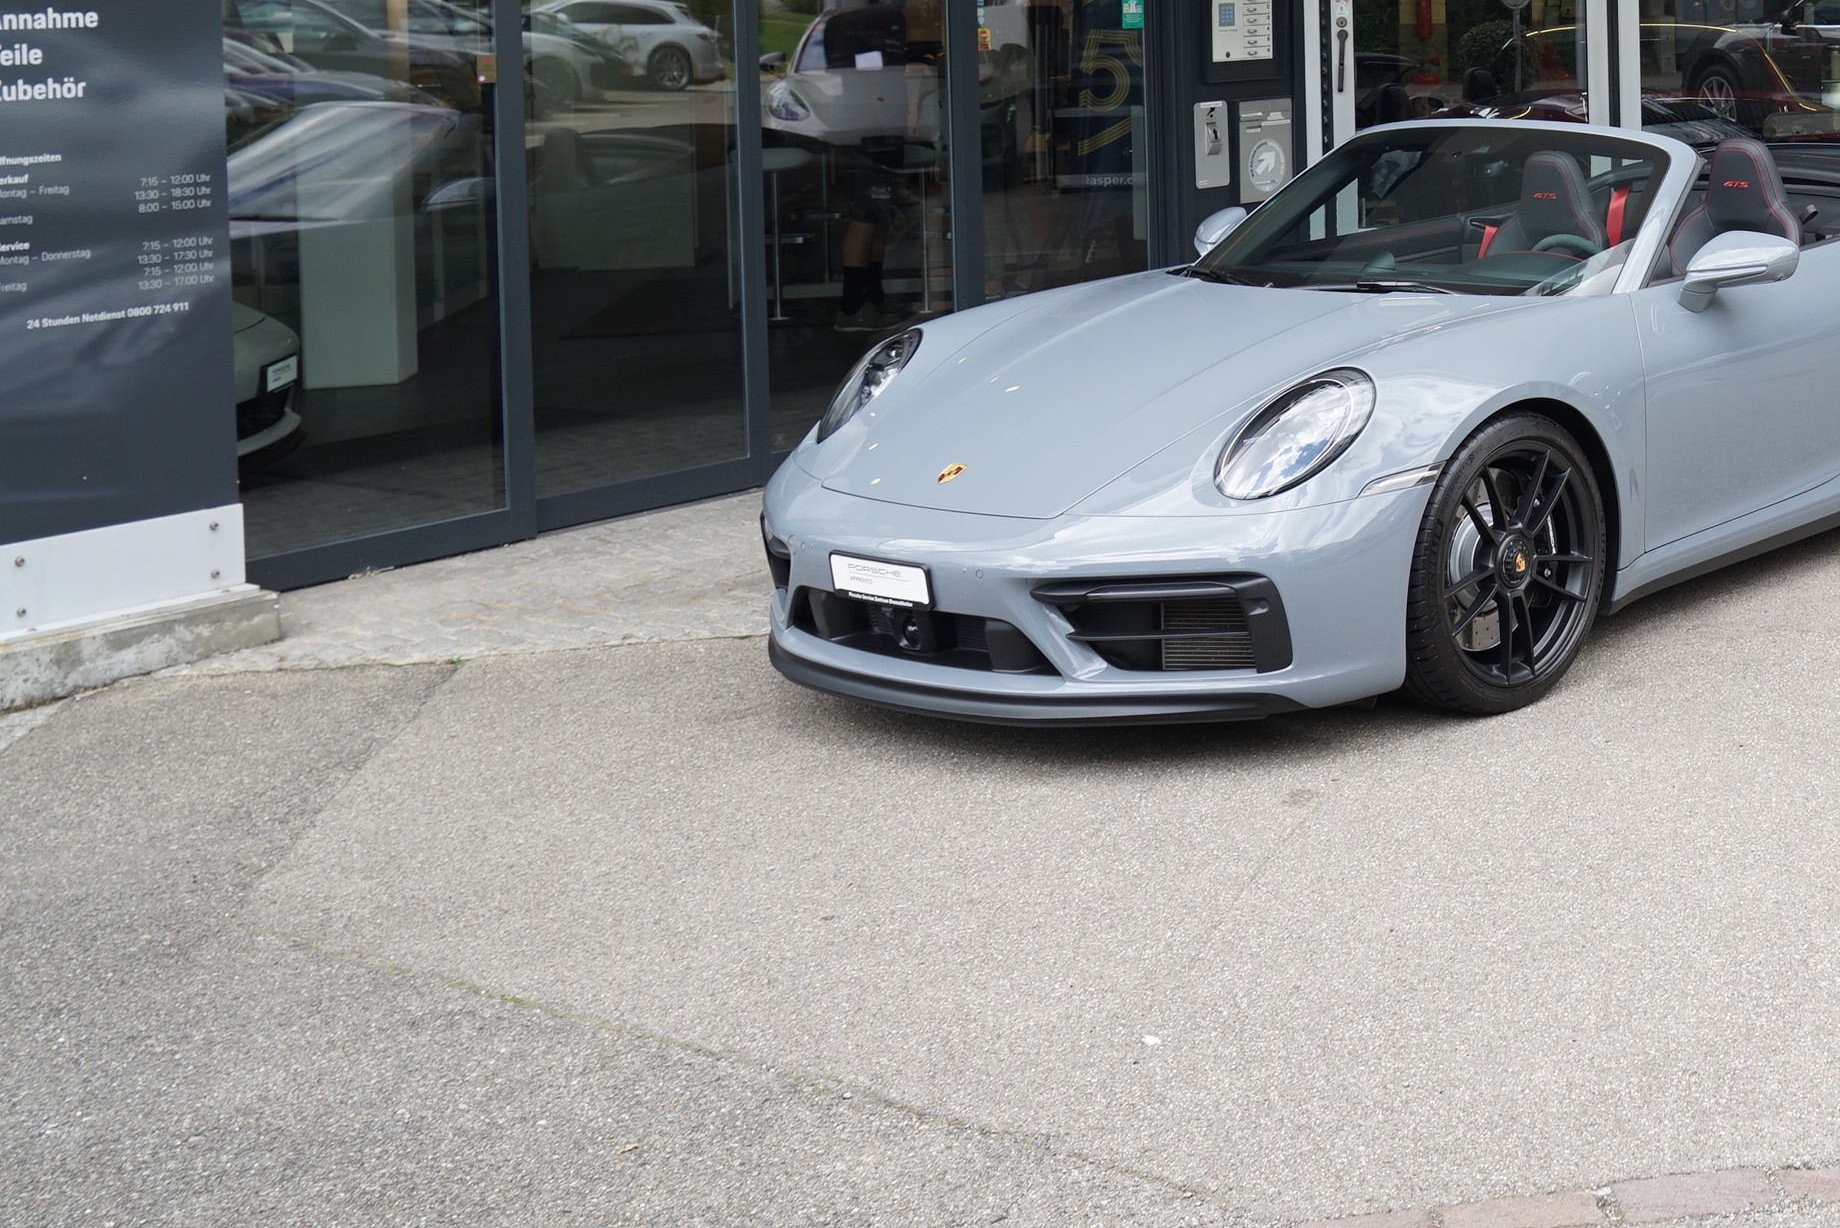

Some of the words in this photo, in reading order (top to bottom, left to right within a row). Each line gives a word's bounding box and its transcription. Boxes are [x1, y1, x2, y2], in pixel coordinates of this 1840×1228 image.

[196, 174, 211, 183] Uhr
[1723, 180, 1749, 189] GTS
[0, 188, 27, 200] ontag
[38, 184, 70, 196] Freitag
[196, 186, 211, 196] Uhr
[1533, 192, 1557, 200] GTS
[197, 198, 212, 209] Uhr
[198, 237, 214, 247] Uhr
[41, 249, 91, 262] Donnerstag
[199, 249, 214, 259] Uhr
[199, 262, 214, 272] Uhr
[199, 275, 215, 284] Uhr
[27, 319, 40, 330] 24
[42, 315, 80, 328] Stunden
[82, 310, 126, 323] Notdienst
[127, 307, 152, 318] 0800
[153, 304, 171, 315] 724
[172, 301, 190, 312] 911
[848, 563, 902, 578] PORSCHE
